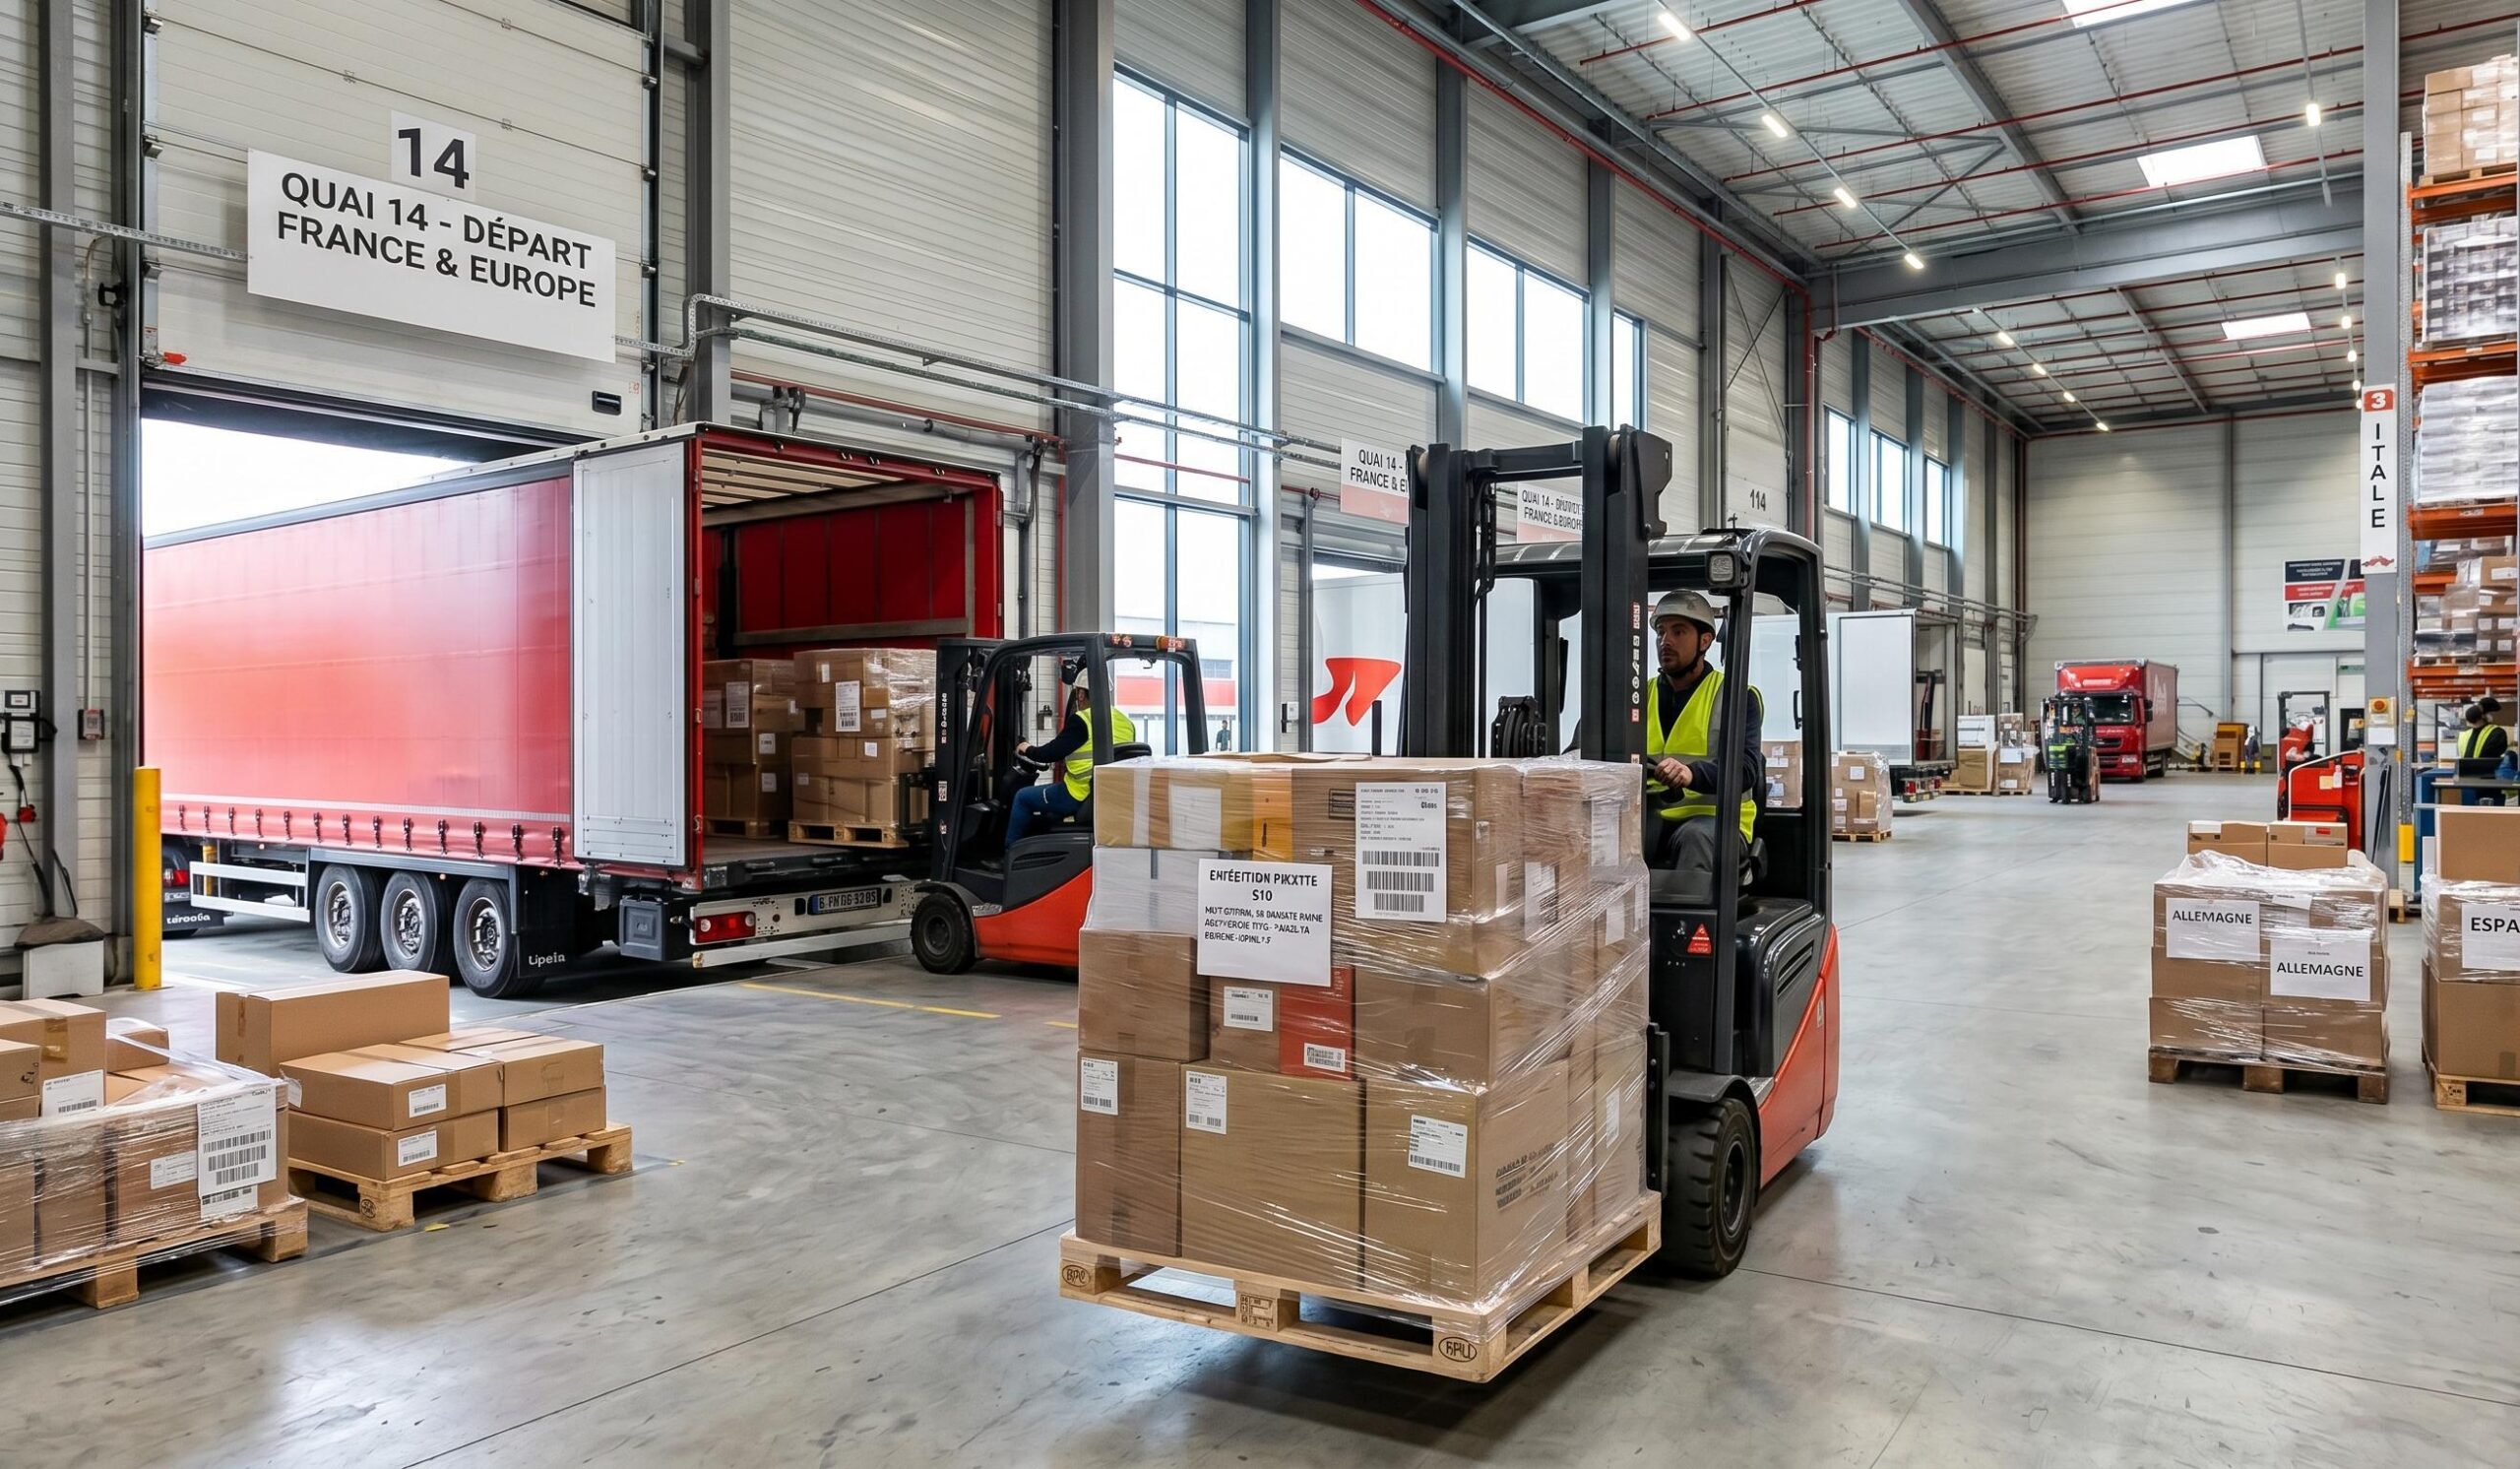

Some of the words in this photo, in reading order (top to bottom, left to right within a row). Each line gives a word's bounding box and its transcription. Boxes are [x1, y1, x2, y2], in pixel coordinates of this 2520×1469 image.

[398, 128, 470, 189] 14
[282, 172, 374, 220] QUAI
[388, 199, 428, 231] 14
[439, 220, 452, 228] -
[464, 215, 592, 270] DÉPART
[278, 211, 425, 270] FRANCE
[436, 248, 459, 278] &
[471, 255, 596, 308] EUROPE
[2370, 392, 2386, 410] 3
[1358, 449, 1383, 468] QUAI
[1386, 456, 1397, 471] 14
[1350, 467, 1389, 488] FRANCE
[2369, 422, 2387, 529] ITALE
[1522, 489, 1540, 505] QUAI
[1750, 488, 1766, 512] 114
[2172, 910, 2252, 925] ALLEMAGNE
[2276, 962, 2363, 978] ALLEMAGNE
